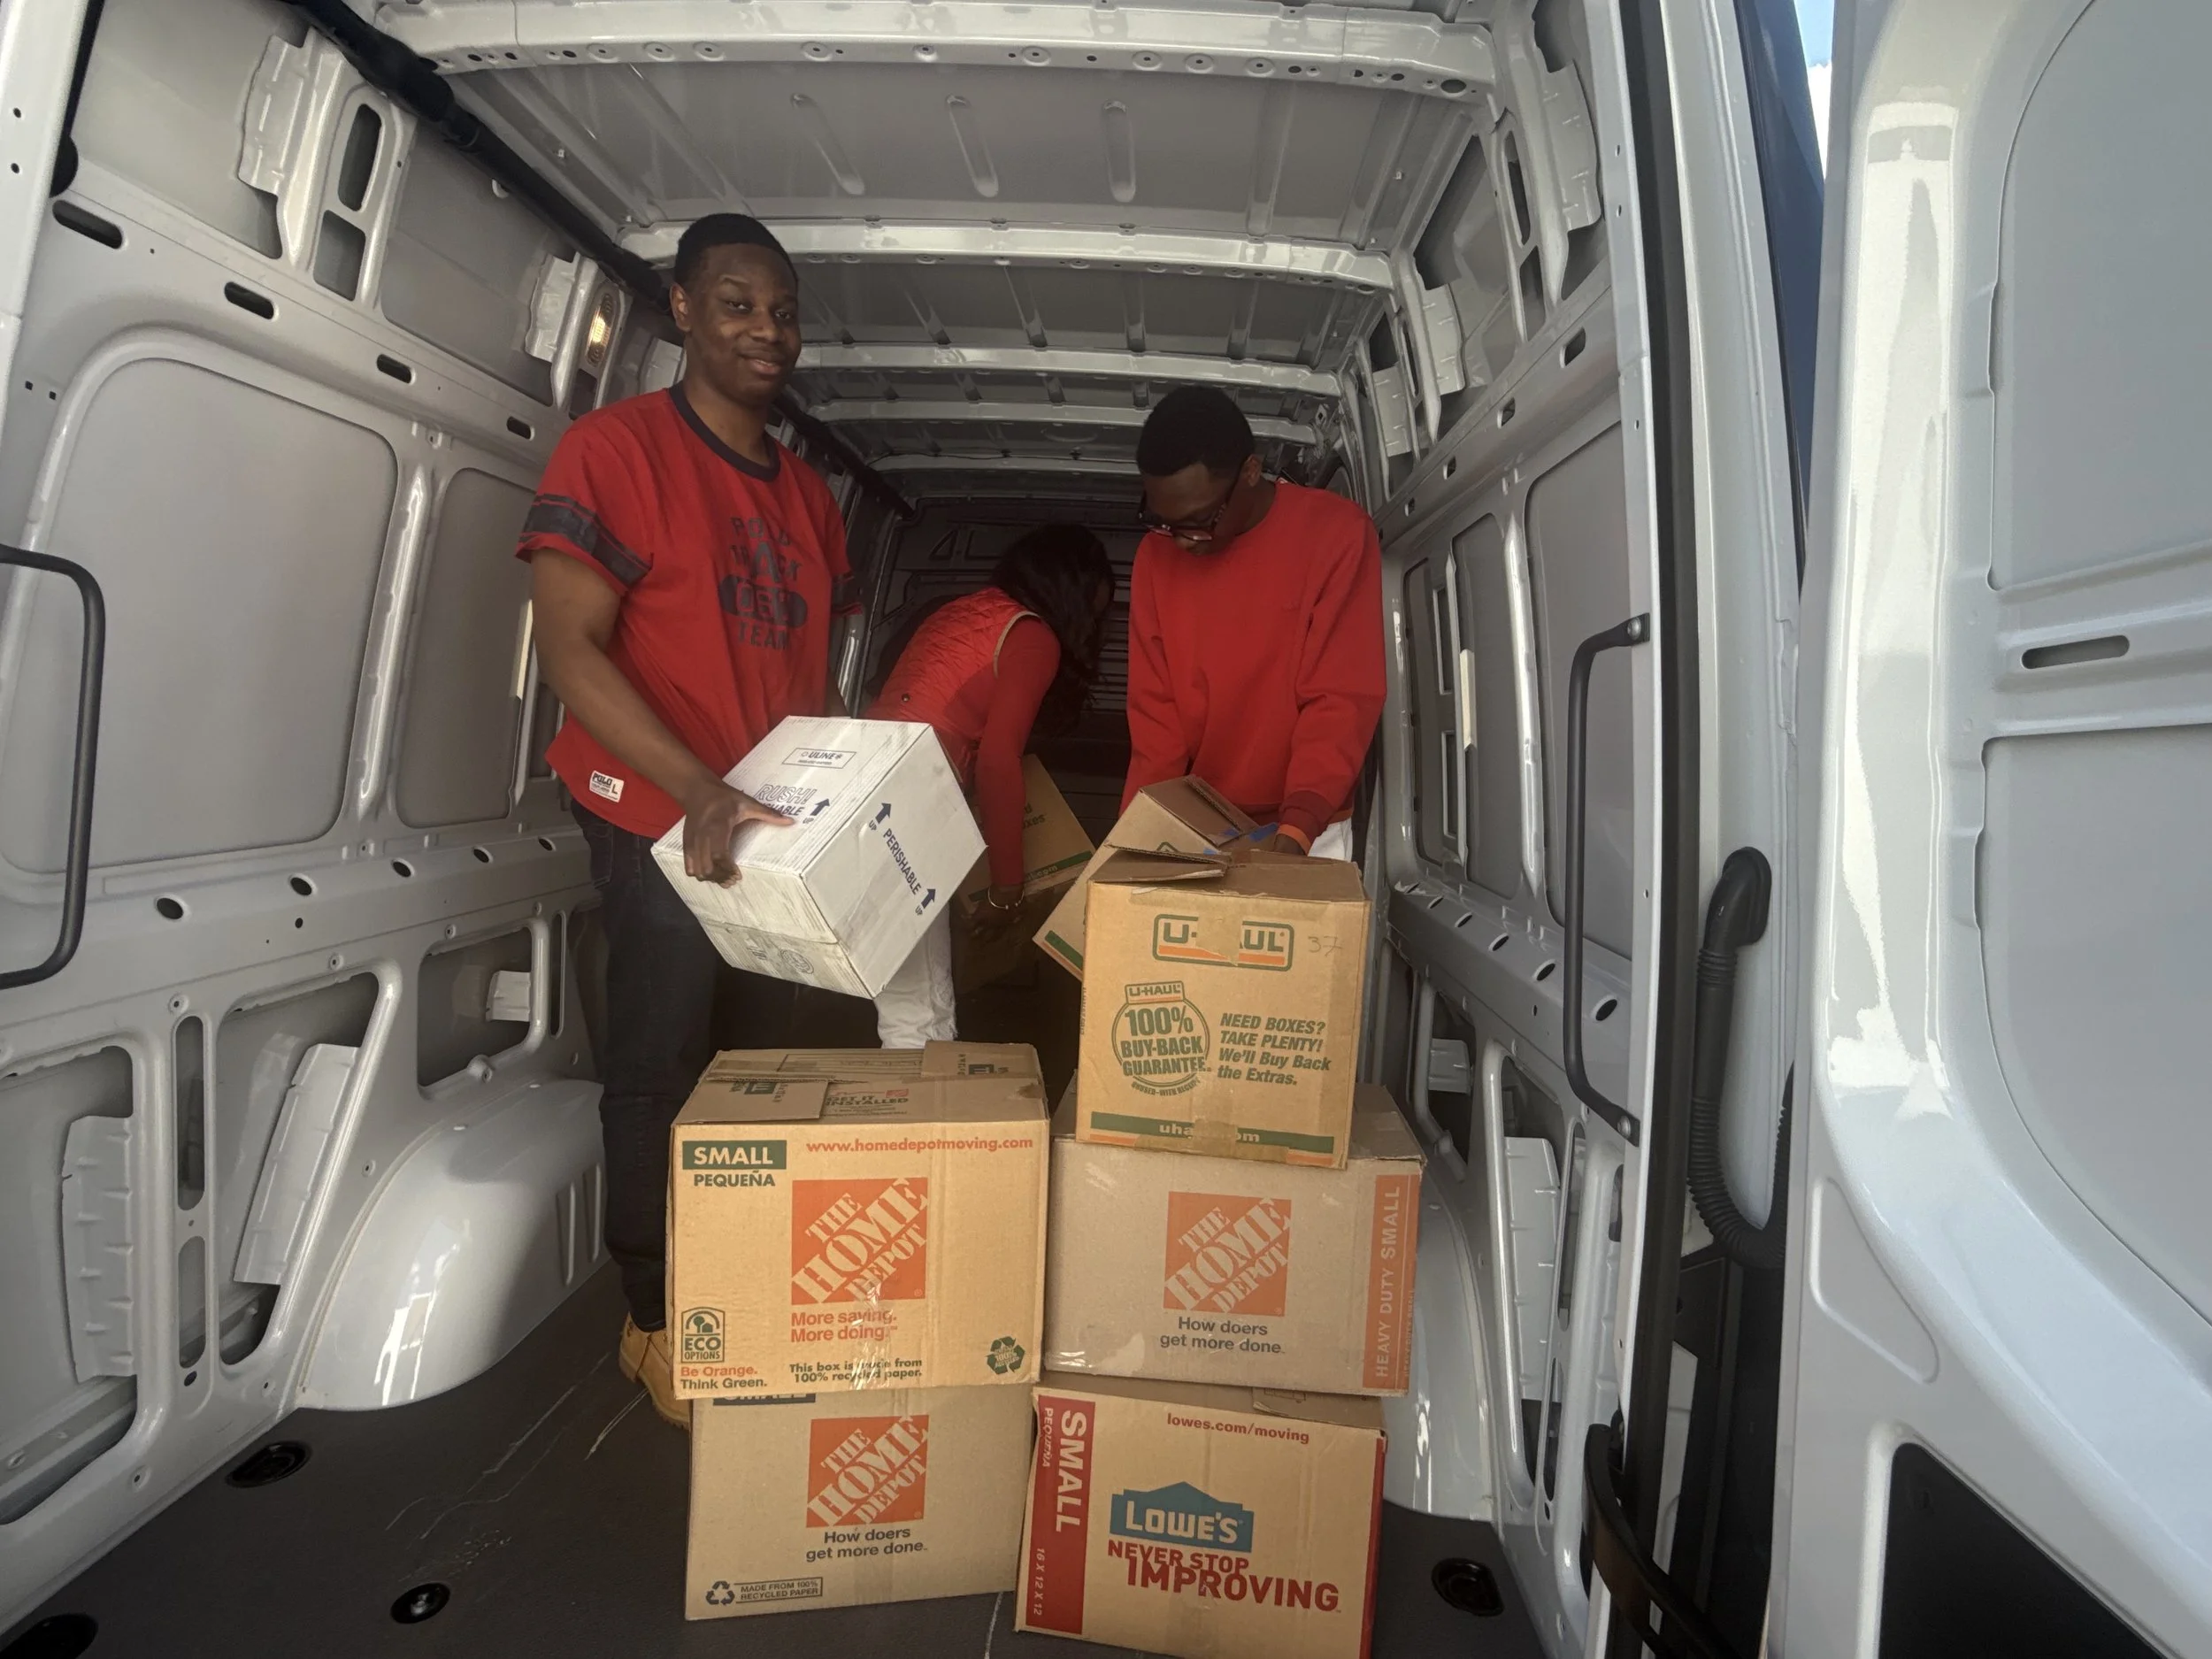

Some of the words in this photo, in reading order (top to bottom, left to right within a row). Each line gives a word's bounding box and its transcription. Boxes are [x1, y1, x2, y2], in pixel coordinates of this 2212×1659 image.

[738, 621, 790, 650] TEAM
[592, 772, 613, 786] POLO
[611, 783, 618, 795] L
[754, 783, 818, 804] RUSH!
[868, 819, 878, 831] UP
[882, 827, 922, 895] PERISHABLE
[915, 904, 924, 917] UP
[1307, 935, 1343, 957] 37
[1128, 984, 1181, 997] U-HAUL
[1125, 1005, 1194, 1036] 100%
[1220, 1012, 1262, 1029] NEED
[1264, 1017, 1325, 1035] BOXES?
[1120, 1035, 1203, 1058] BUY-BACK
[1220, 1030, 1258, 1047] TAKE
[1261, 1033, 1324, 1052] PLENTY!
[1218, 1048, 1256, 1064] We'll
[1259, 1051, 1290, 1069] Buy
[1292, 1055, 1333, 1071] Back
[1217, 1064, 1242, 1080] the
[1245, 1067, 1298, 1086] Extras.
[693, 1146, 773, 1165] SMALL
[805, 1136, 1033, 1155] www.homedepotmoving.com
[693, 1170, 776, 1187] PEQUEÑA
[804, 1192, 864, 1243] THE
[1380, 1186, 1401, 1259] SMALL
[791, 1177, 928, 1303] HOME
[1178, 1206, 1231, 1253] THE
[844, 1223, 927, 1304] DEPOT
[1164, 1196, 1291, 1311] HOME
[1211, 1241, 1288, 1314] DEPOT
[1379, 1267, 1394, 1314] DUTY
[791, 1312, 834, 1326] More
[837, 1310, 897, 1325] saving.
[1178, 1316, 1216, 1333] How
[1220, 1320, 1268, 1335] doers
[684, 1337, 721, 1351] ECO
[791, 1328, 834, 1343] More
[1160, 1334, 1187, 1348] get
[1191, 1336, 1235, 1350] more
[684, 1350, 720, 1361] OPTIONS
[1375, 1320, 1392, 1378] HEAVY
[680, 1366, 699, 1377] Be
[703, 1365, 758, 1378] Orange.
[789, 1363, 813, 1373] This
[817, 1362, 841, 1371] box
[844, 1360, 854, 1371] is
[895, 1357, 923, 1368] from
[795, 1372, 829, 1383] 100%
[885, 1369, 922, 1381] paper.
[680, 1379, 718, 1390] Think
[722, 1378, 768, 1388] Green.
[1041, 1406, 1054, 1468] PEQUEÑA
[1166, 1412, 1310, 1445] lowes.com/moving
[820, 1428, 872, 1474] THE
[807, 1416, 929, 1527] HOME
[1055, 1409, 1087, 1533] SMALL
[853, 1454, 927, 1525] DEPOT
[1125, 1500, 1239, 1544] LOWE'S
[824, 1531, 861, 1544] How
[864, 1528, 911, 1540] doers
[806, 1548, 833, 1563] get
[837, 1546, 879, 1558] more
[1036, 1548, 1046, 1563] 16
[1108, 1539, 1184, 1568] NEVER
[1189, 1552, 1249, 1576] STOP
[768, 1582, 795, 1591] FROM
[797, 1579, 818, 1588] 100%
[1034, 1575, 1044, 1590] 12
[1127, 1555, 1339, 1612] IMPROVING
[741, 1590, 787, 1601] RECYCLED
[789, 1587, 818, 1596] PAPER
[1033, 1601, 1043, 1616] 12
